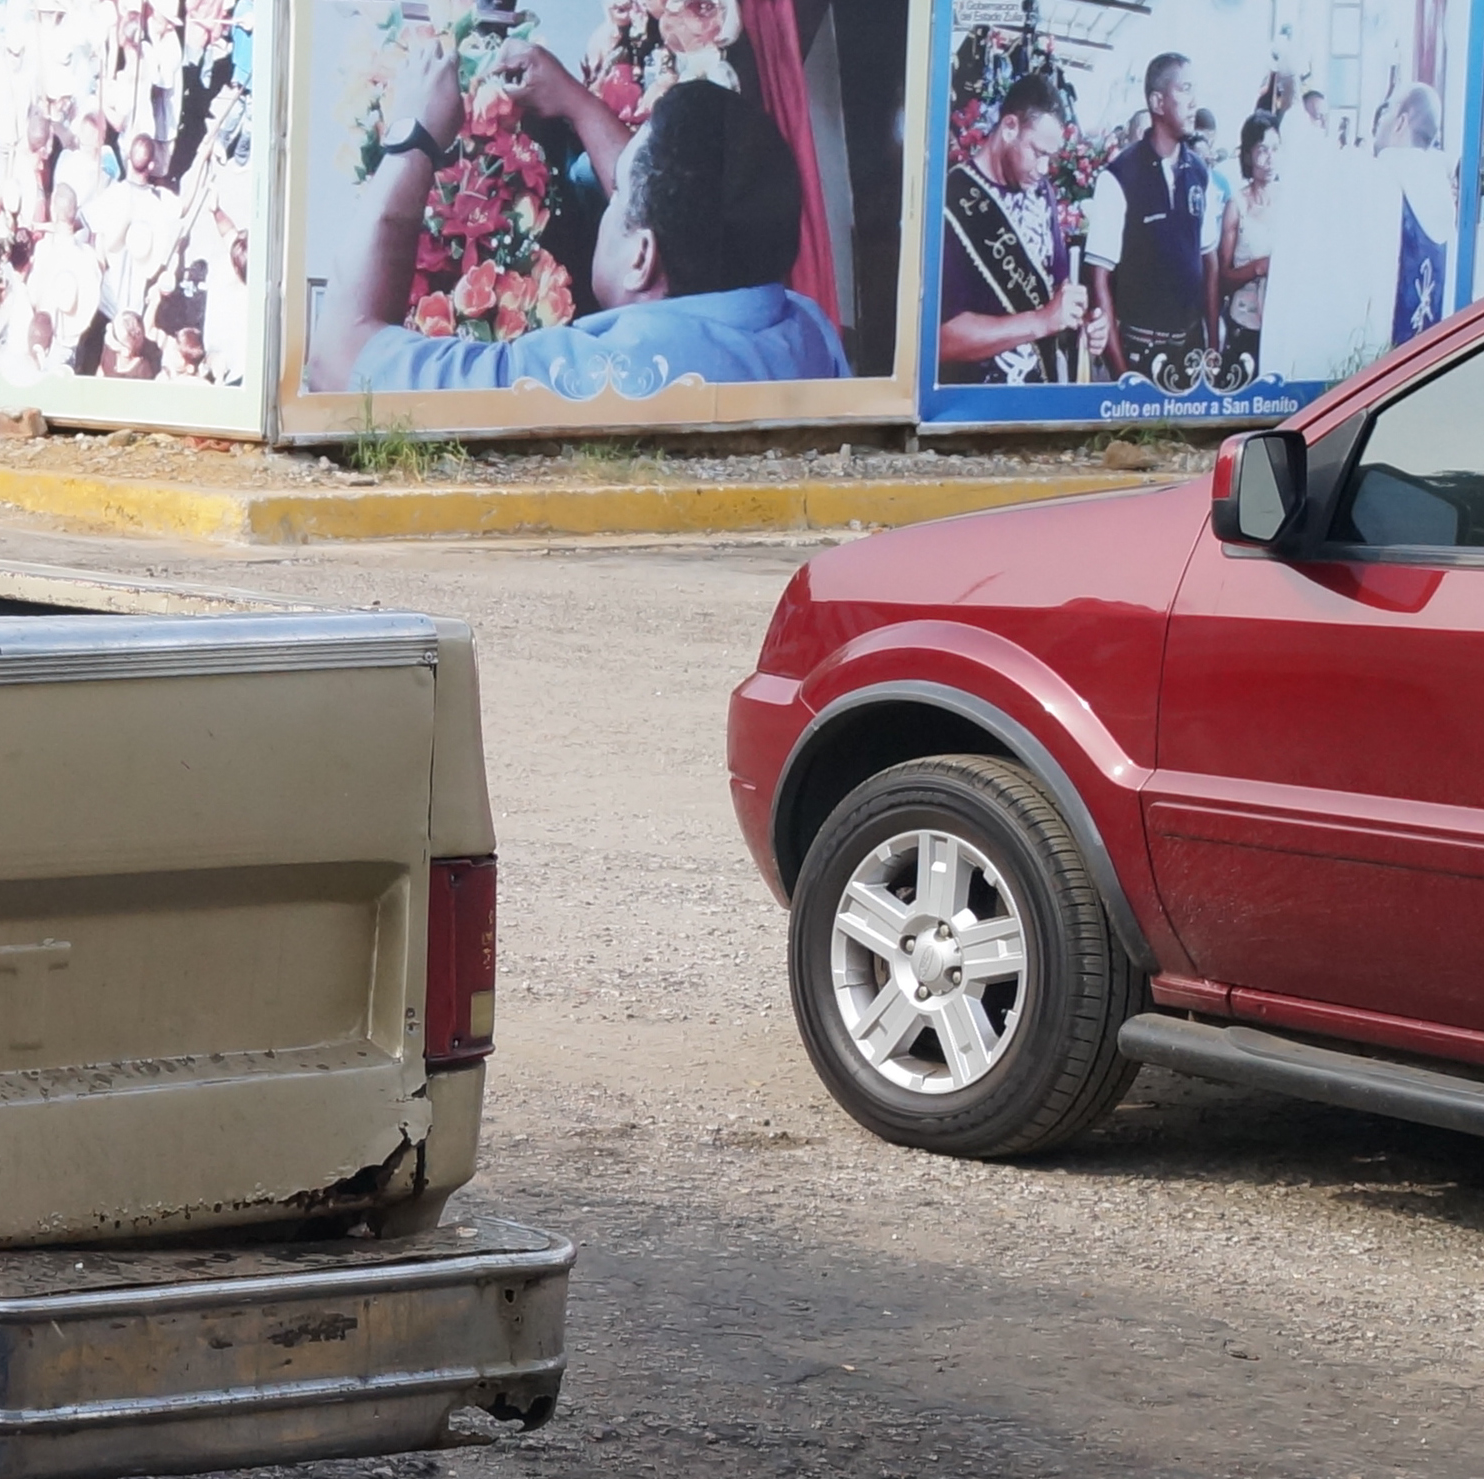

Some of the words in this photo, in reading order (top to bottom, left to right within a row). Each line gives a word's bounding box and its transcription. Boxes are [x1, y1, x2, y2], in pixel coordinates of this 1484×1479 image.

[1100, 400, 1140, 418] Culto
[1142, 404, 1160, 417] en
[1164, 398, 1207, 416] Honor
[1210, 403, 1219, 415] a
[1222, 396, 1250, 415] San
[1252, 395, 1299, 413] Benito
